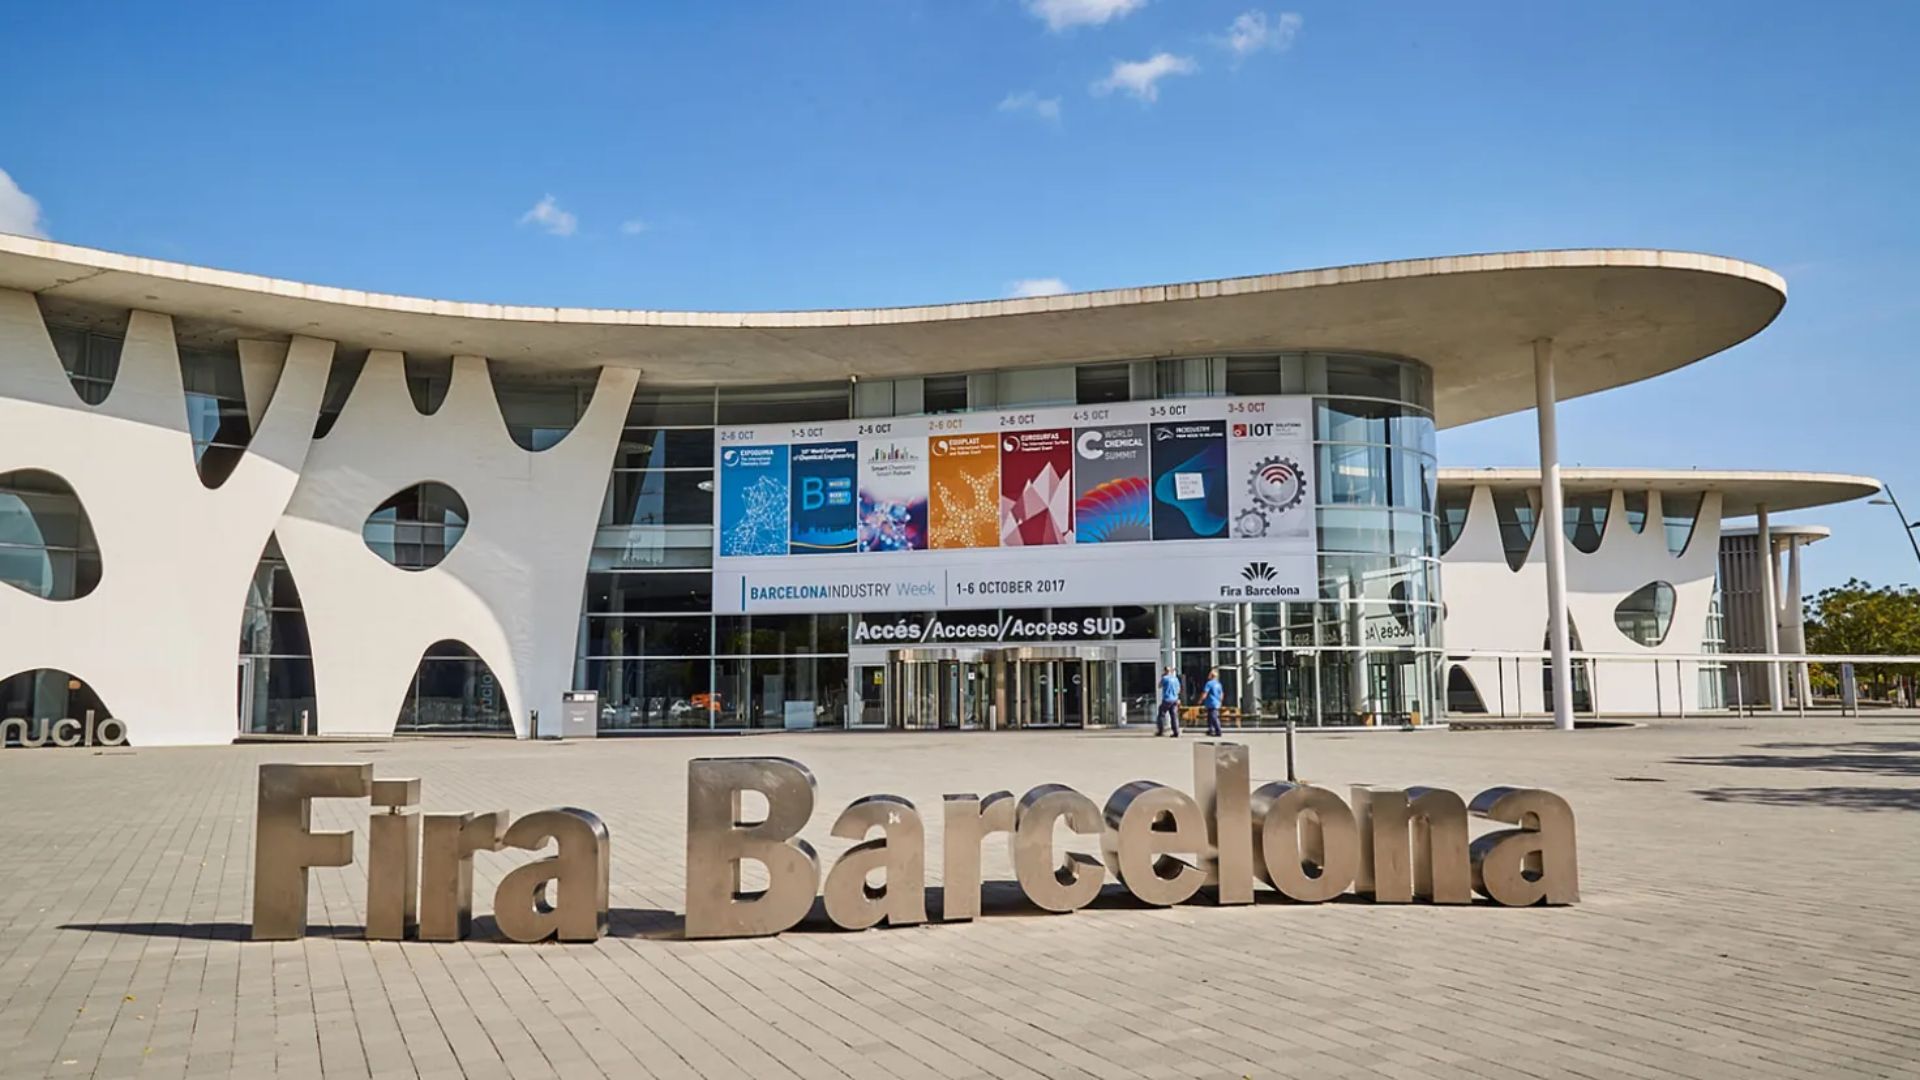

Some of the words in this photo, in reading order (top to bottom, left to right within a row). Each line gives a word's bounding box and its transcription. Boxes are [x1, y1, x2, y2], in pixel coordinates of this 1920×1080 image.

[1150, 406, 1166, 416] 3-5
[1169, 405, 1186, 415] OCT
[1228, 403, 1244, 413] 3-5
[1248, 402, 1265, 412] OCT
[1000, 416, 1014, 425] 2-6
[1018, 414, 1035, 424] OCT
[1073, 411, 1088, 420] 4-5
[1092, 410, 1109, 419] OCT
[858, 425, 873, 434] 2-6
[875, 424, 891, 433] OCT
[929, 421, 943, 430] 2-6
[946, 419, 963, 429] OCT
[1249, 423, 1273, 437] IOT
[721, 431, 736, 440] 2-6
[738, 431, 754, 440] OCT
[791, 429, 804, 438] 1-5
[807, 428, 823, 437] OCT
[1104, 429, 1133, 439] WORLD
[1104, 438, 1144, 448] CHEMICAL
[1104, 450, 1137, 460] SUMMIT
[750, 583, 891, 600] BARCELONAINDUSTRY
[896, 580, 935, 597] Week
[957, 582, 975, 595] 1-6
[979, 581, 1033, 594] OCTOBER
[1037, 579, 1065, 592] 2017
[1220, 585, 1242, 596] Fira
[1245, 585, 1300, 596] Barcelona
[1083, 618, 1126, 635] SUD
[253, 762, 608, 943] Fira
[685, 740, 1581, 940] Barcelona
